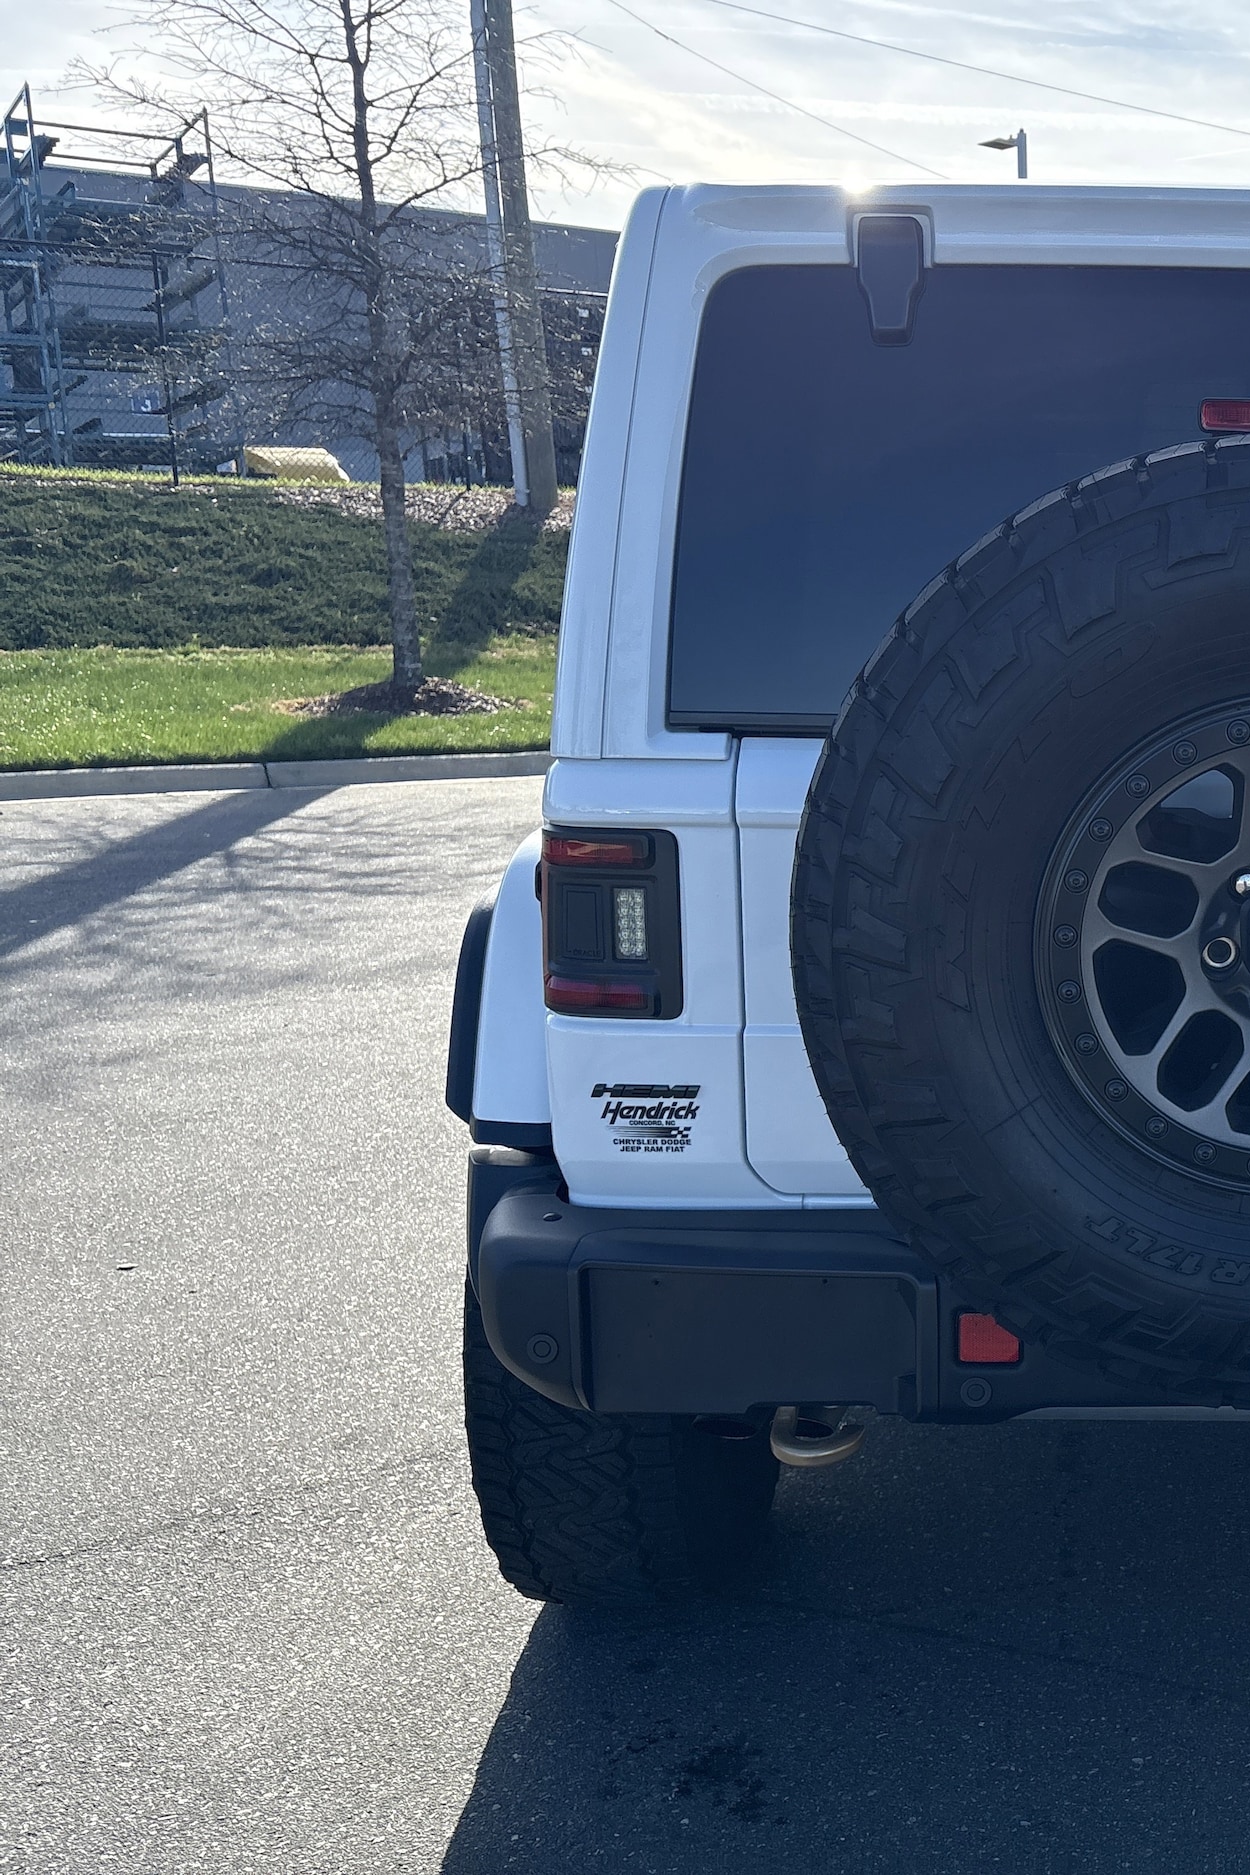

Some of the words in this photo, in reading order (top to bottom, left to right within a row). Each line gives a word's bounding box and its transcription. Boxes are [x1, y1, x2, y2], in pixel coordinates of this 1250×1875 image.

[590, 1083, 701, 1098] HEMI
[600, 1101, 700, 1125] Hendrick
[613, 1138, 658, 1146] CHRYSLER
[661, 1138, 692, 1146] DODGE
